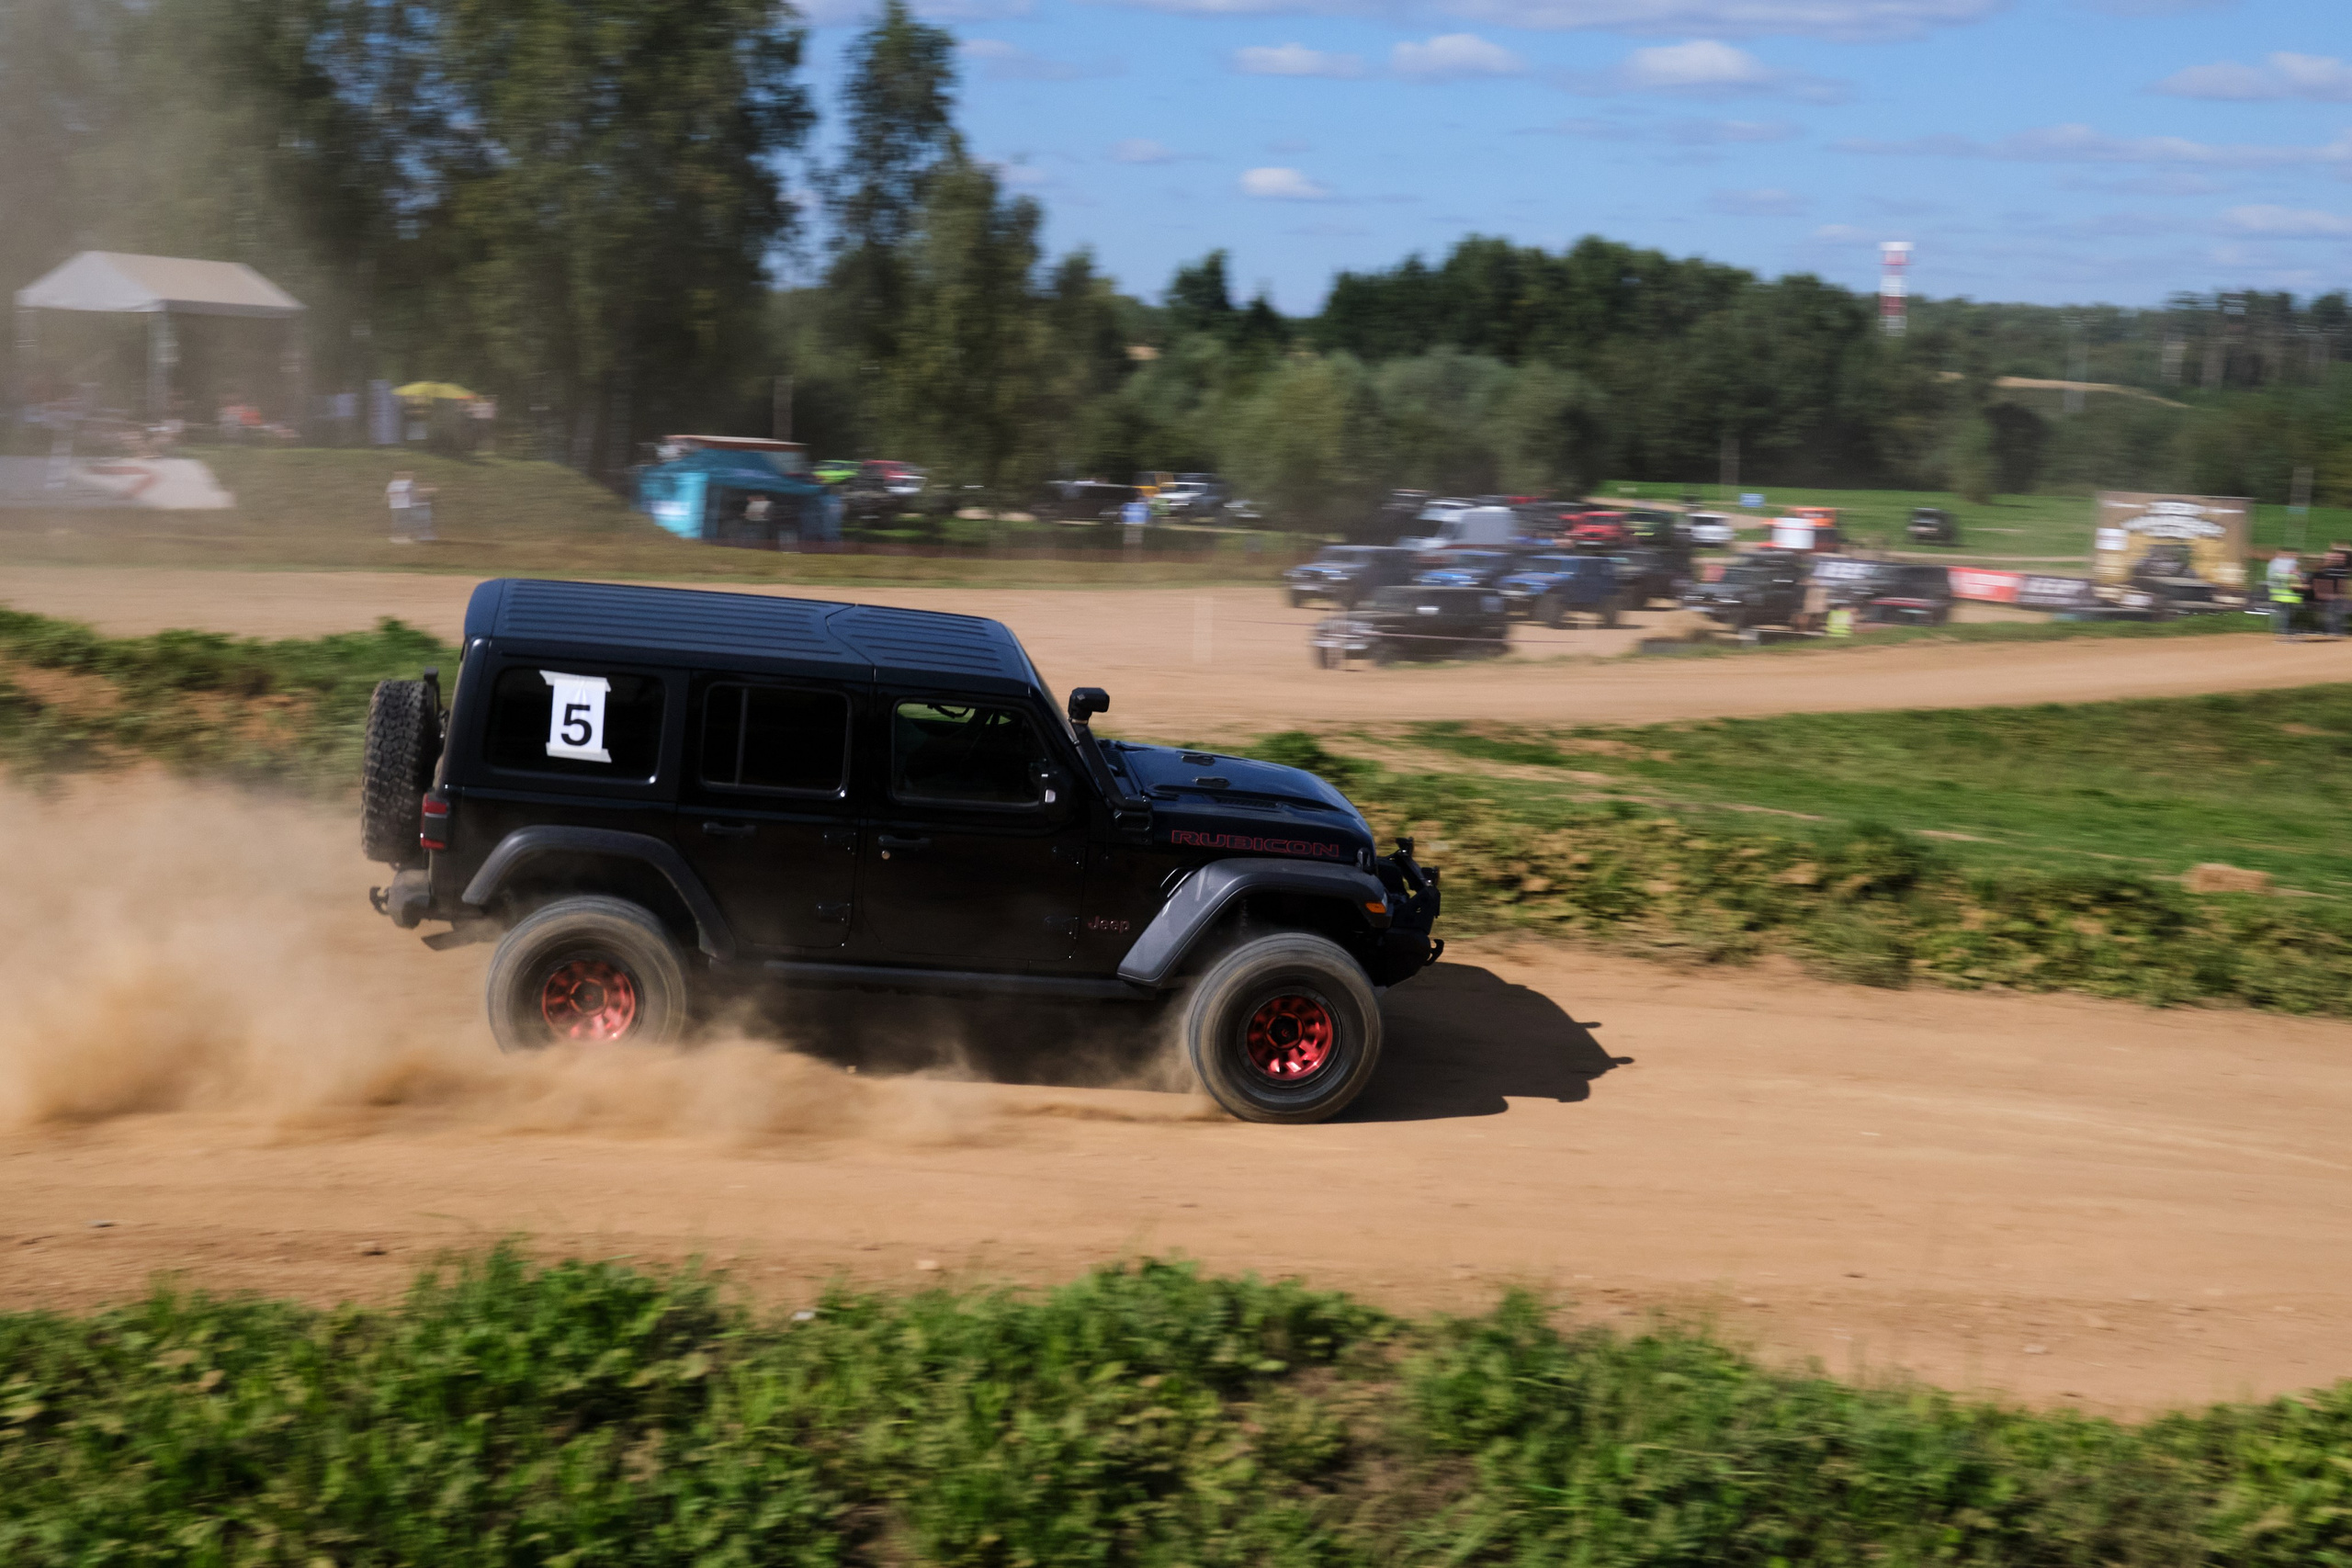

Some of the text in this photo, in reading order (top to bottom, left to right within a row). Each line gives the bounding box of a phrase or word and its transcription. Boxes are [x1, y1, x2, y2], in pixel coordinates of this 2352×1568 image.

[560, 703, 593, 747] 5
[1171, 829, 1340, 858] RUBICON
[1087, 915, 1130, 934] Jeep
